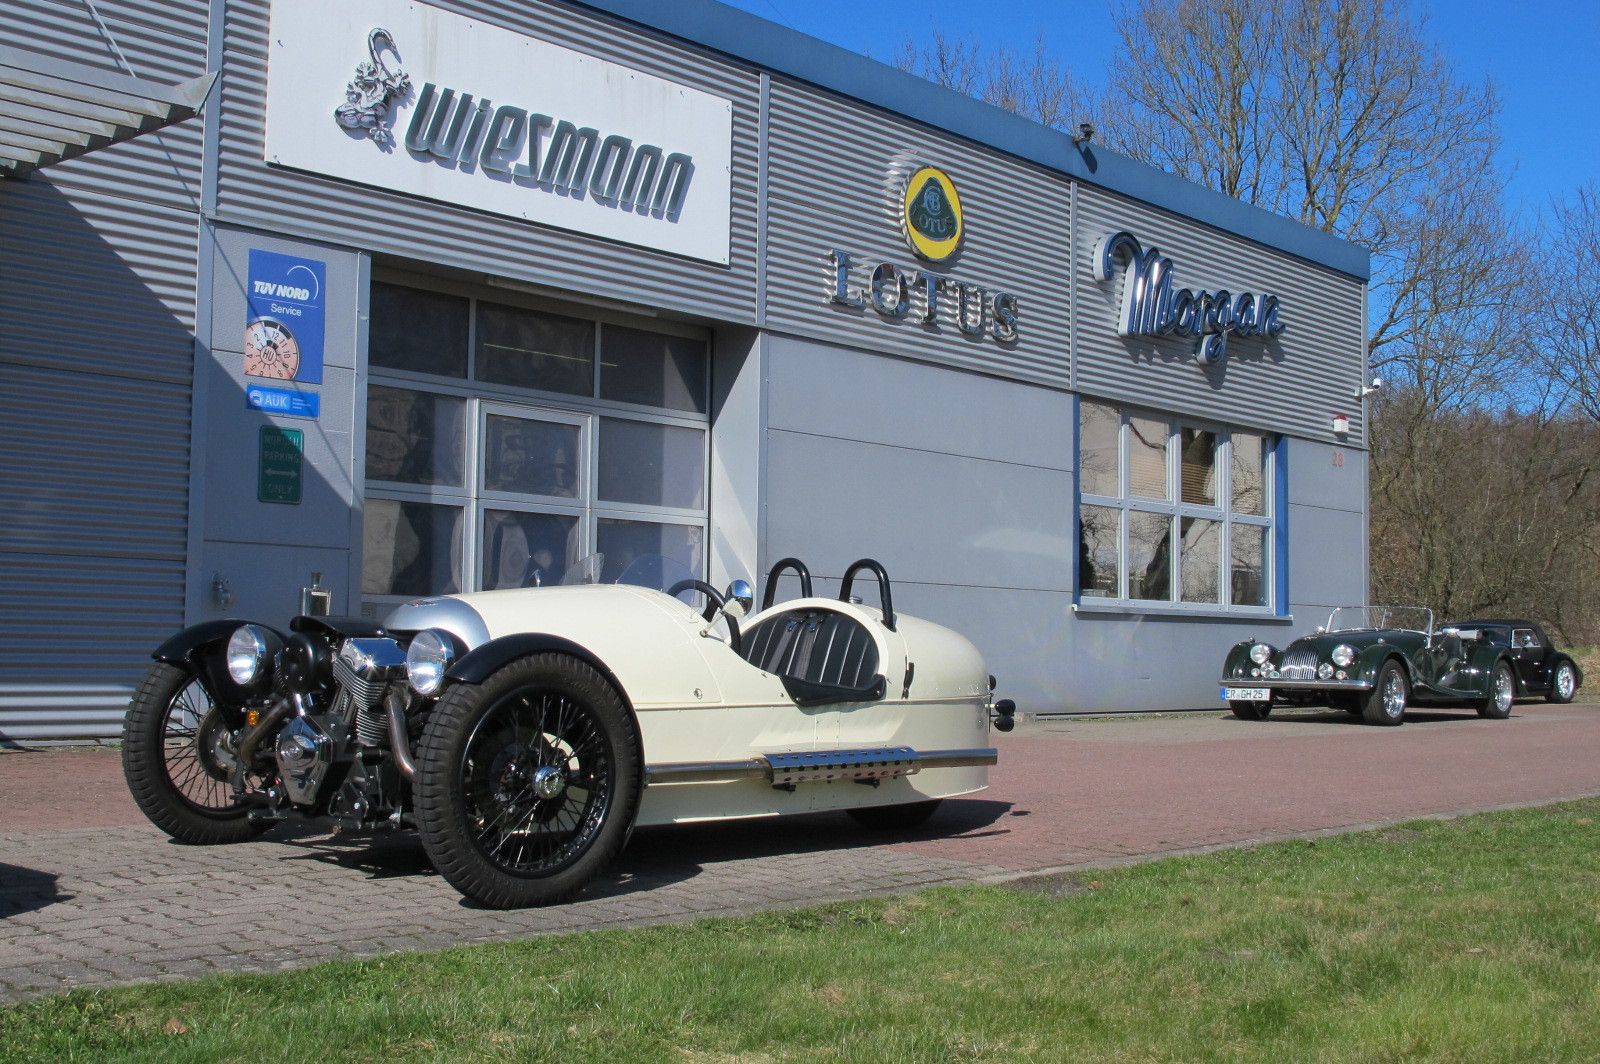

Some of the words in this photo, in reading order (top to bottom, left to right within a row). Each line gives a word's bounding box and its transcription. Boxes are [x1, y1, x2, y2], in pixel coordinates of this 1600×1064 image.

[404, 82, 692, 214] Wiesmann
[276, 285, 310, 301] NORD
[829, 249, 1019, 342] LOTUS
[1093, 231, 1286, 364] Morgan
[270, 303, 302, 316] Service
[262, 349, 275, 361] HU
[1225, 689, 1236, 699] ER
[1253, 690, 1263, 699] 25
